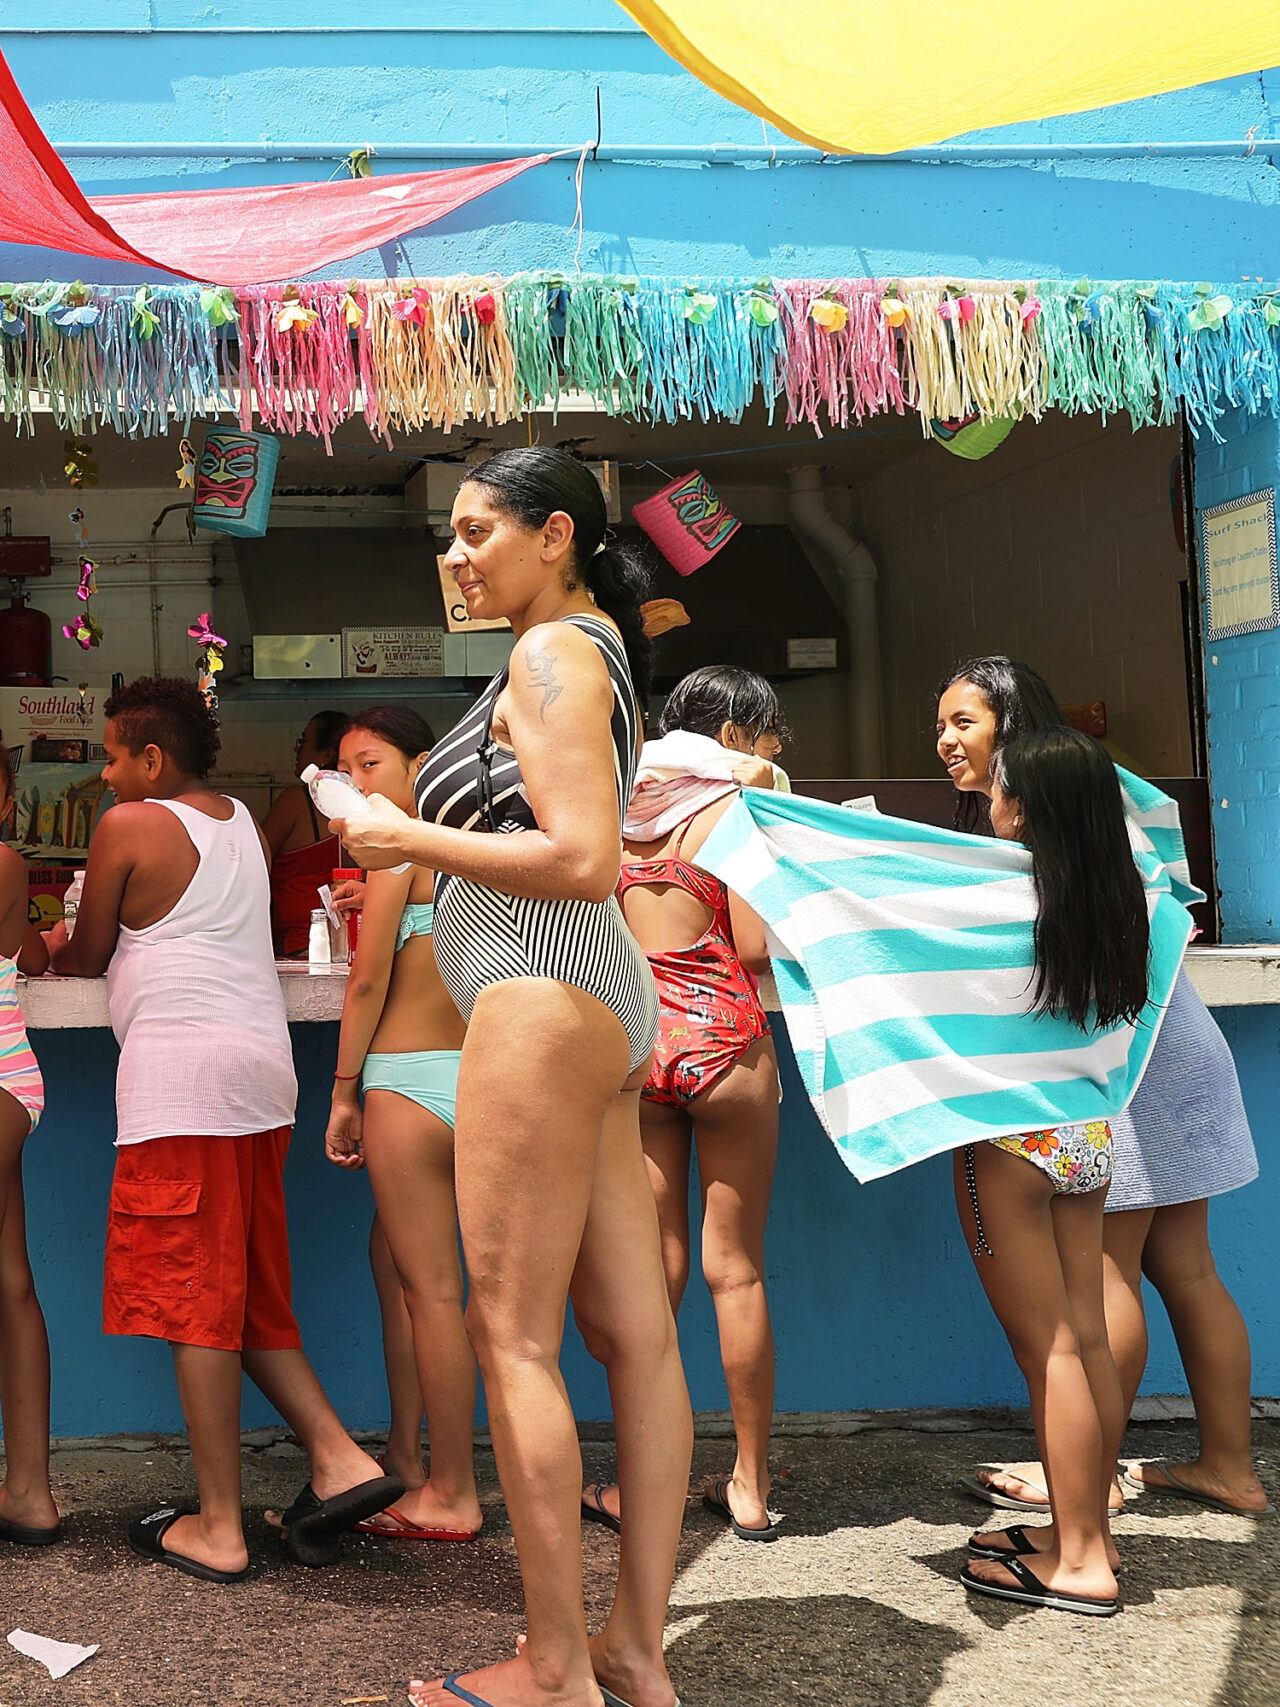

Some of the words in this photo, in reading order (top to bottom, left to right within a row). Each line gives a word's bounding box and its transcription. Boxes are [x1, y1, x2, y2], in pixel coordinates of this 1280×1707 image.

[1207, 524, 1232, 539] Surf
[373, 632, 412, 640] KITCHEN
[415, 632, 442, 640] RULES
